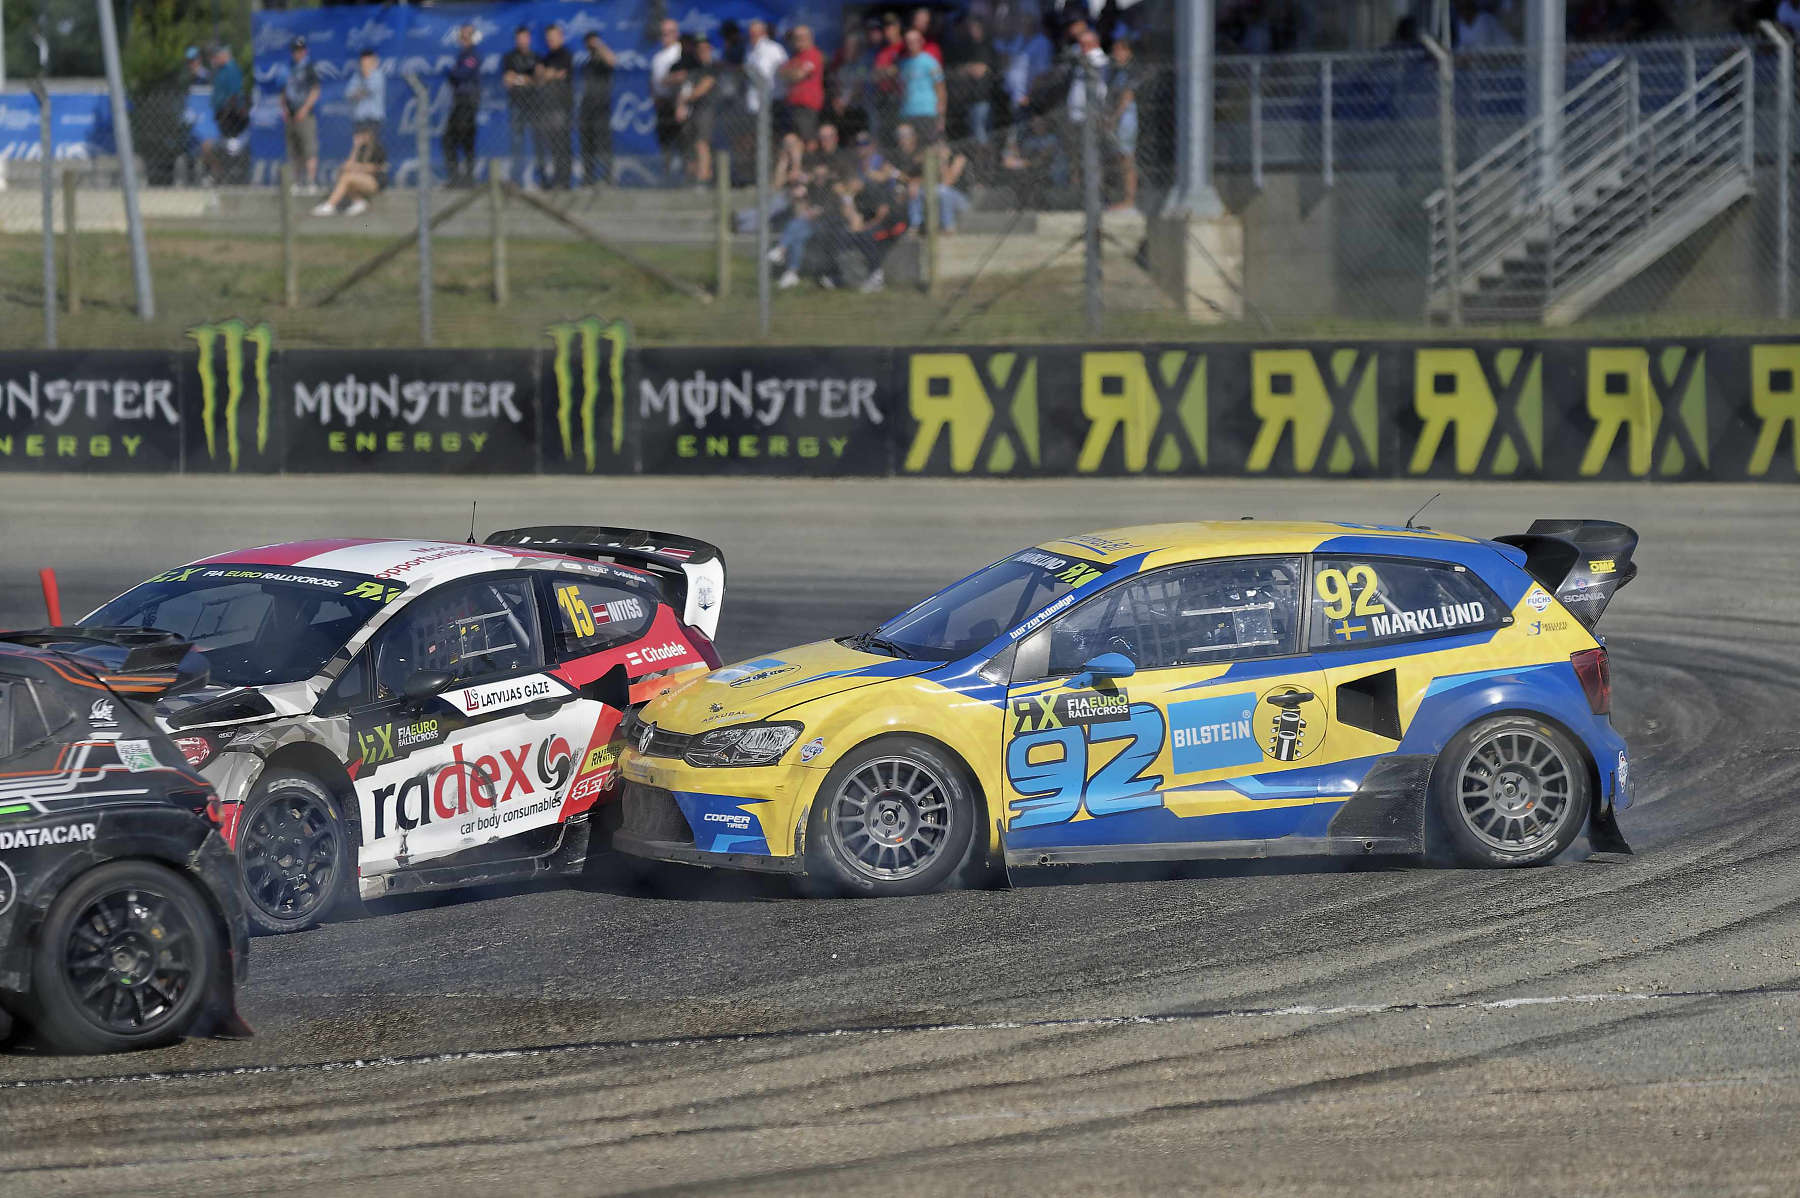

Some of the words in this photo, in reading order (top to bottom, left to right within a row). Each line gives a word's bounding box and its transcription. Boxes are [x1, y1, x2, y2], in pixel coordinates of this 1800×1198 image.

[0, 371, 180, 426] NSTER
[294, 373, 523, 427] MONSTER
[639, 370, 884, 429] MONSTER
[0, 434, 142, 457] NERGY
[328, 431, 488, 453] ENERGY
[676, 434, 849, 457] ENERGY
[224, 570, 263, 578] EURO
[261, 572, 343, 587] RALLYCROSS
[1589, 562, 1616, 573] OMP
[1316, 565, 1386, 620] 92
[1527, 596, 1552, 606] FUCHS
[1563, 592, 1606, 603] SCANIA
[558, 585, 596, 638] 15
[606, 598, 644, 623] NITISS
[1371, 601, 1485, 637] MARKLUND
[641, 641, 688, 663] Citadele
[481, 687, 523, 708] LATVIJAS
[1068, 704, 1130, 719] RALLYCROSS
[398, 730, 439, 749] RALLYCROSS
[1173, 719, 1251, 748] BILSTEIN
[801, 744, 825, 755] FUCHS
[1006, 701, 1166, 832] 92
[371, 743, 536, 841] radex
[460, 821, 475, 835] car
[477, 813, 501, 830] body
[503, 796, 562, 823] consumables
[704, 813, 751, 824] COOPER
[726, 822, 749, 830] TIRES
[0, 823, 96, 850] DATACAR
